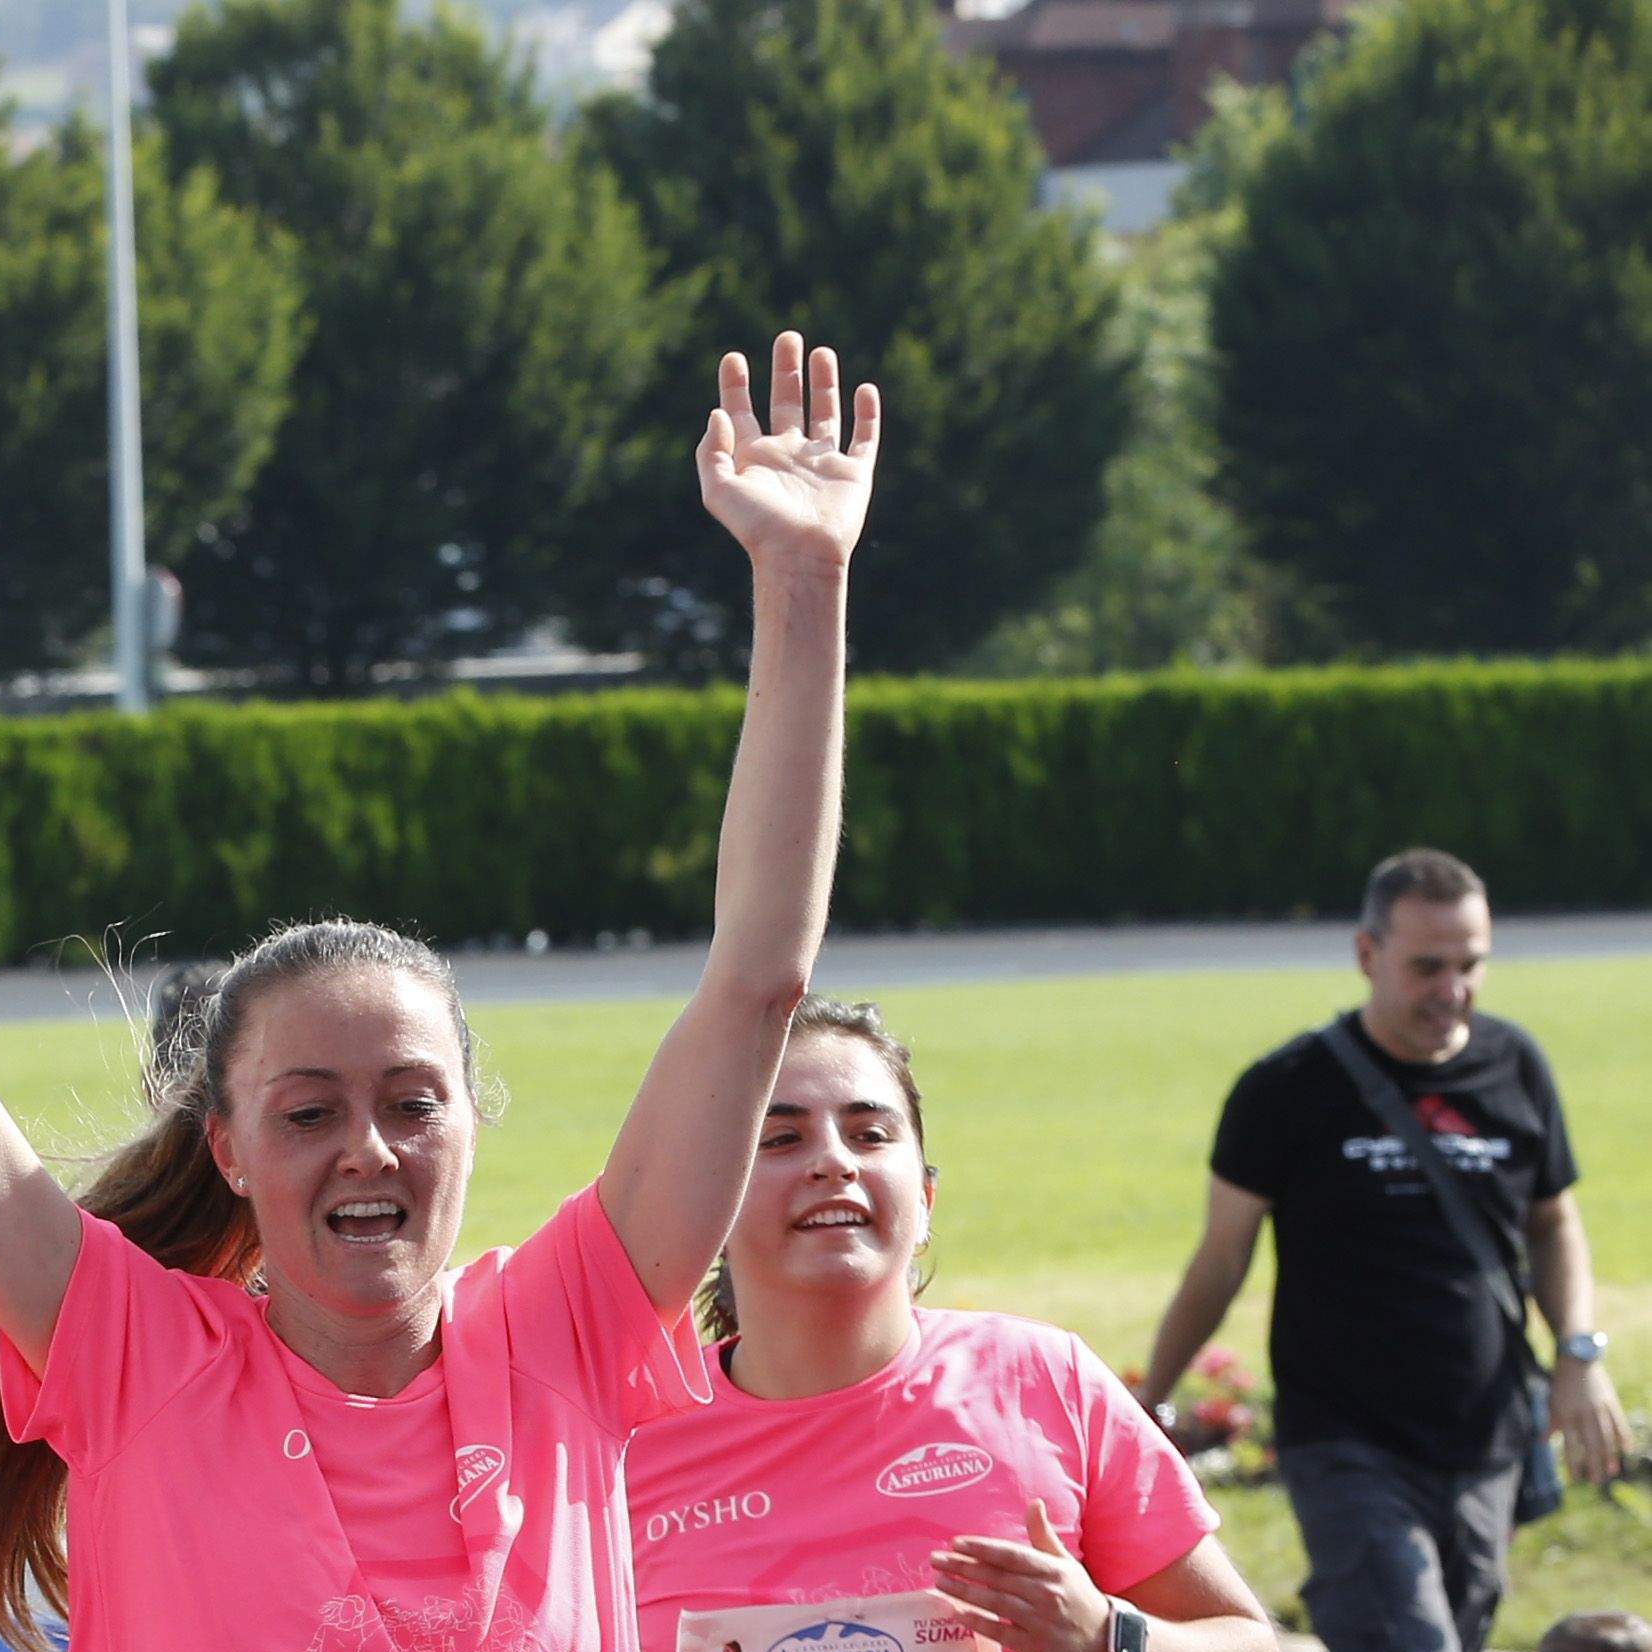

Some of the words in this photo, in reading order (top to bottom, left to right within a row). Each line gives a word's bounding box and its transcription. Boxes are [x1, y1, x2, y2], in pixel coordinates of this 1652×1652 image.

[886, 1457, 986, 1494] ASTURIANA
[646, 1491, 772, 1541] OYSHO
[915, 1625, 975, 1645] SUMA
